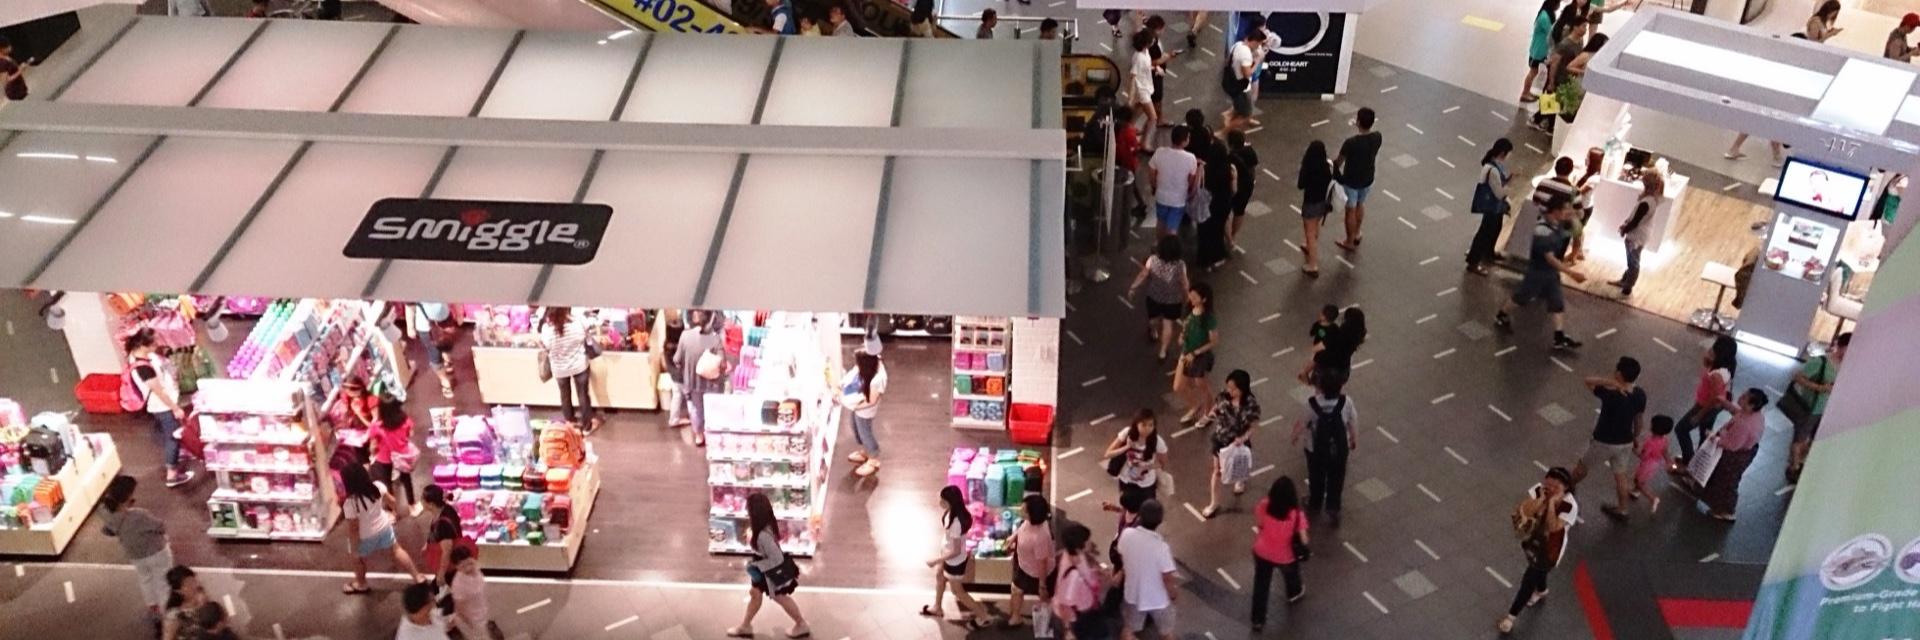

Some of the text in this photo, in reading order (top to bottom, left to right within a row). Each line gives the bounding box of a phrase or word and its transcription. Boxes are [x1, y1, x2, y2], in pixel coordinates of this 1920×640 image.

[1819, 589, 1919, 606] Premium-Grade
[1854, 605, 1867, 613] to
[1870, 601, 1905, 612] Fight
